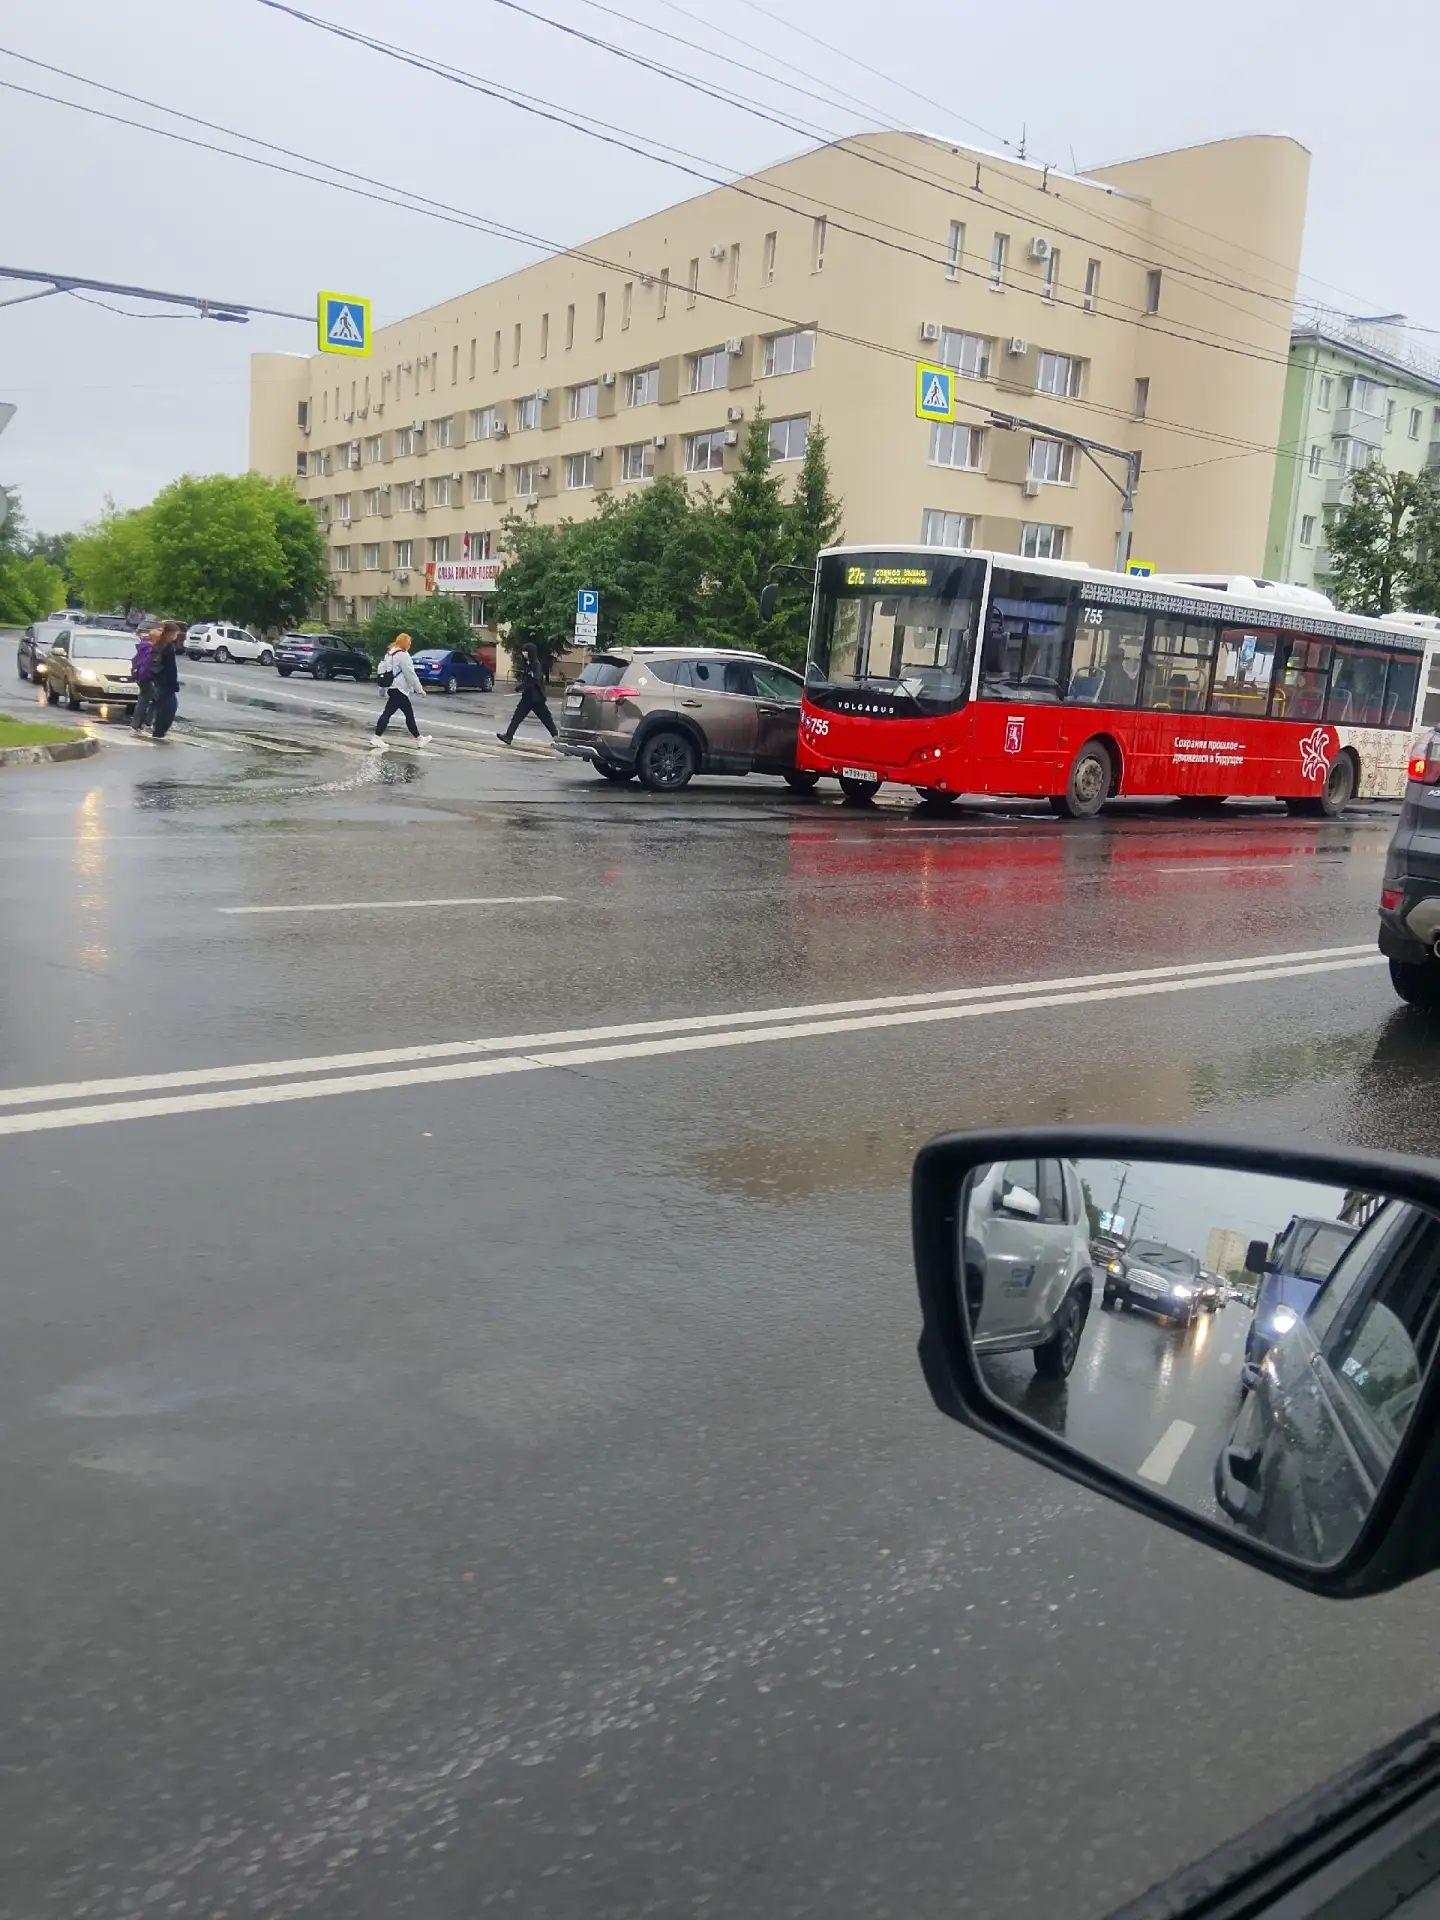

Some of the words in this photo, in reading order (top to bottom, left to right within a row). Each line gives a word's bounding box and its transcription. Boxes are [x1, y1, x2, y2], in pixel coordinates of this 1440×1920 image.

[1084, 607, 1103, 625] 755
[838, 701, 894, 714] VOLGABUS
[811, 717, 829, 736] 755
[1174, 736, 1207, 750] Сохраняя
[1208, 740, 1239, 751] прошлое
[1215, 752, 1244, 766] будущее
